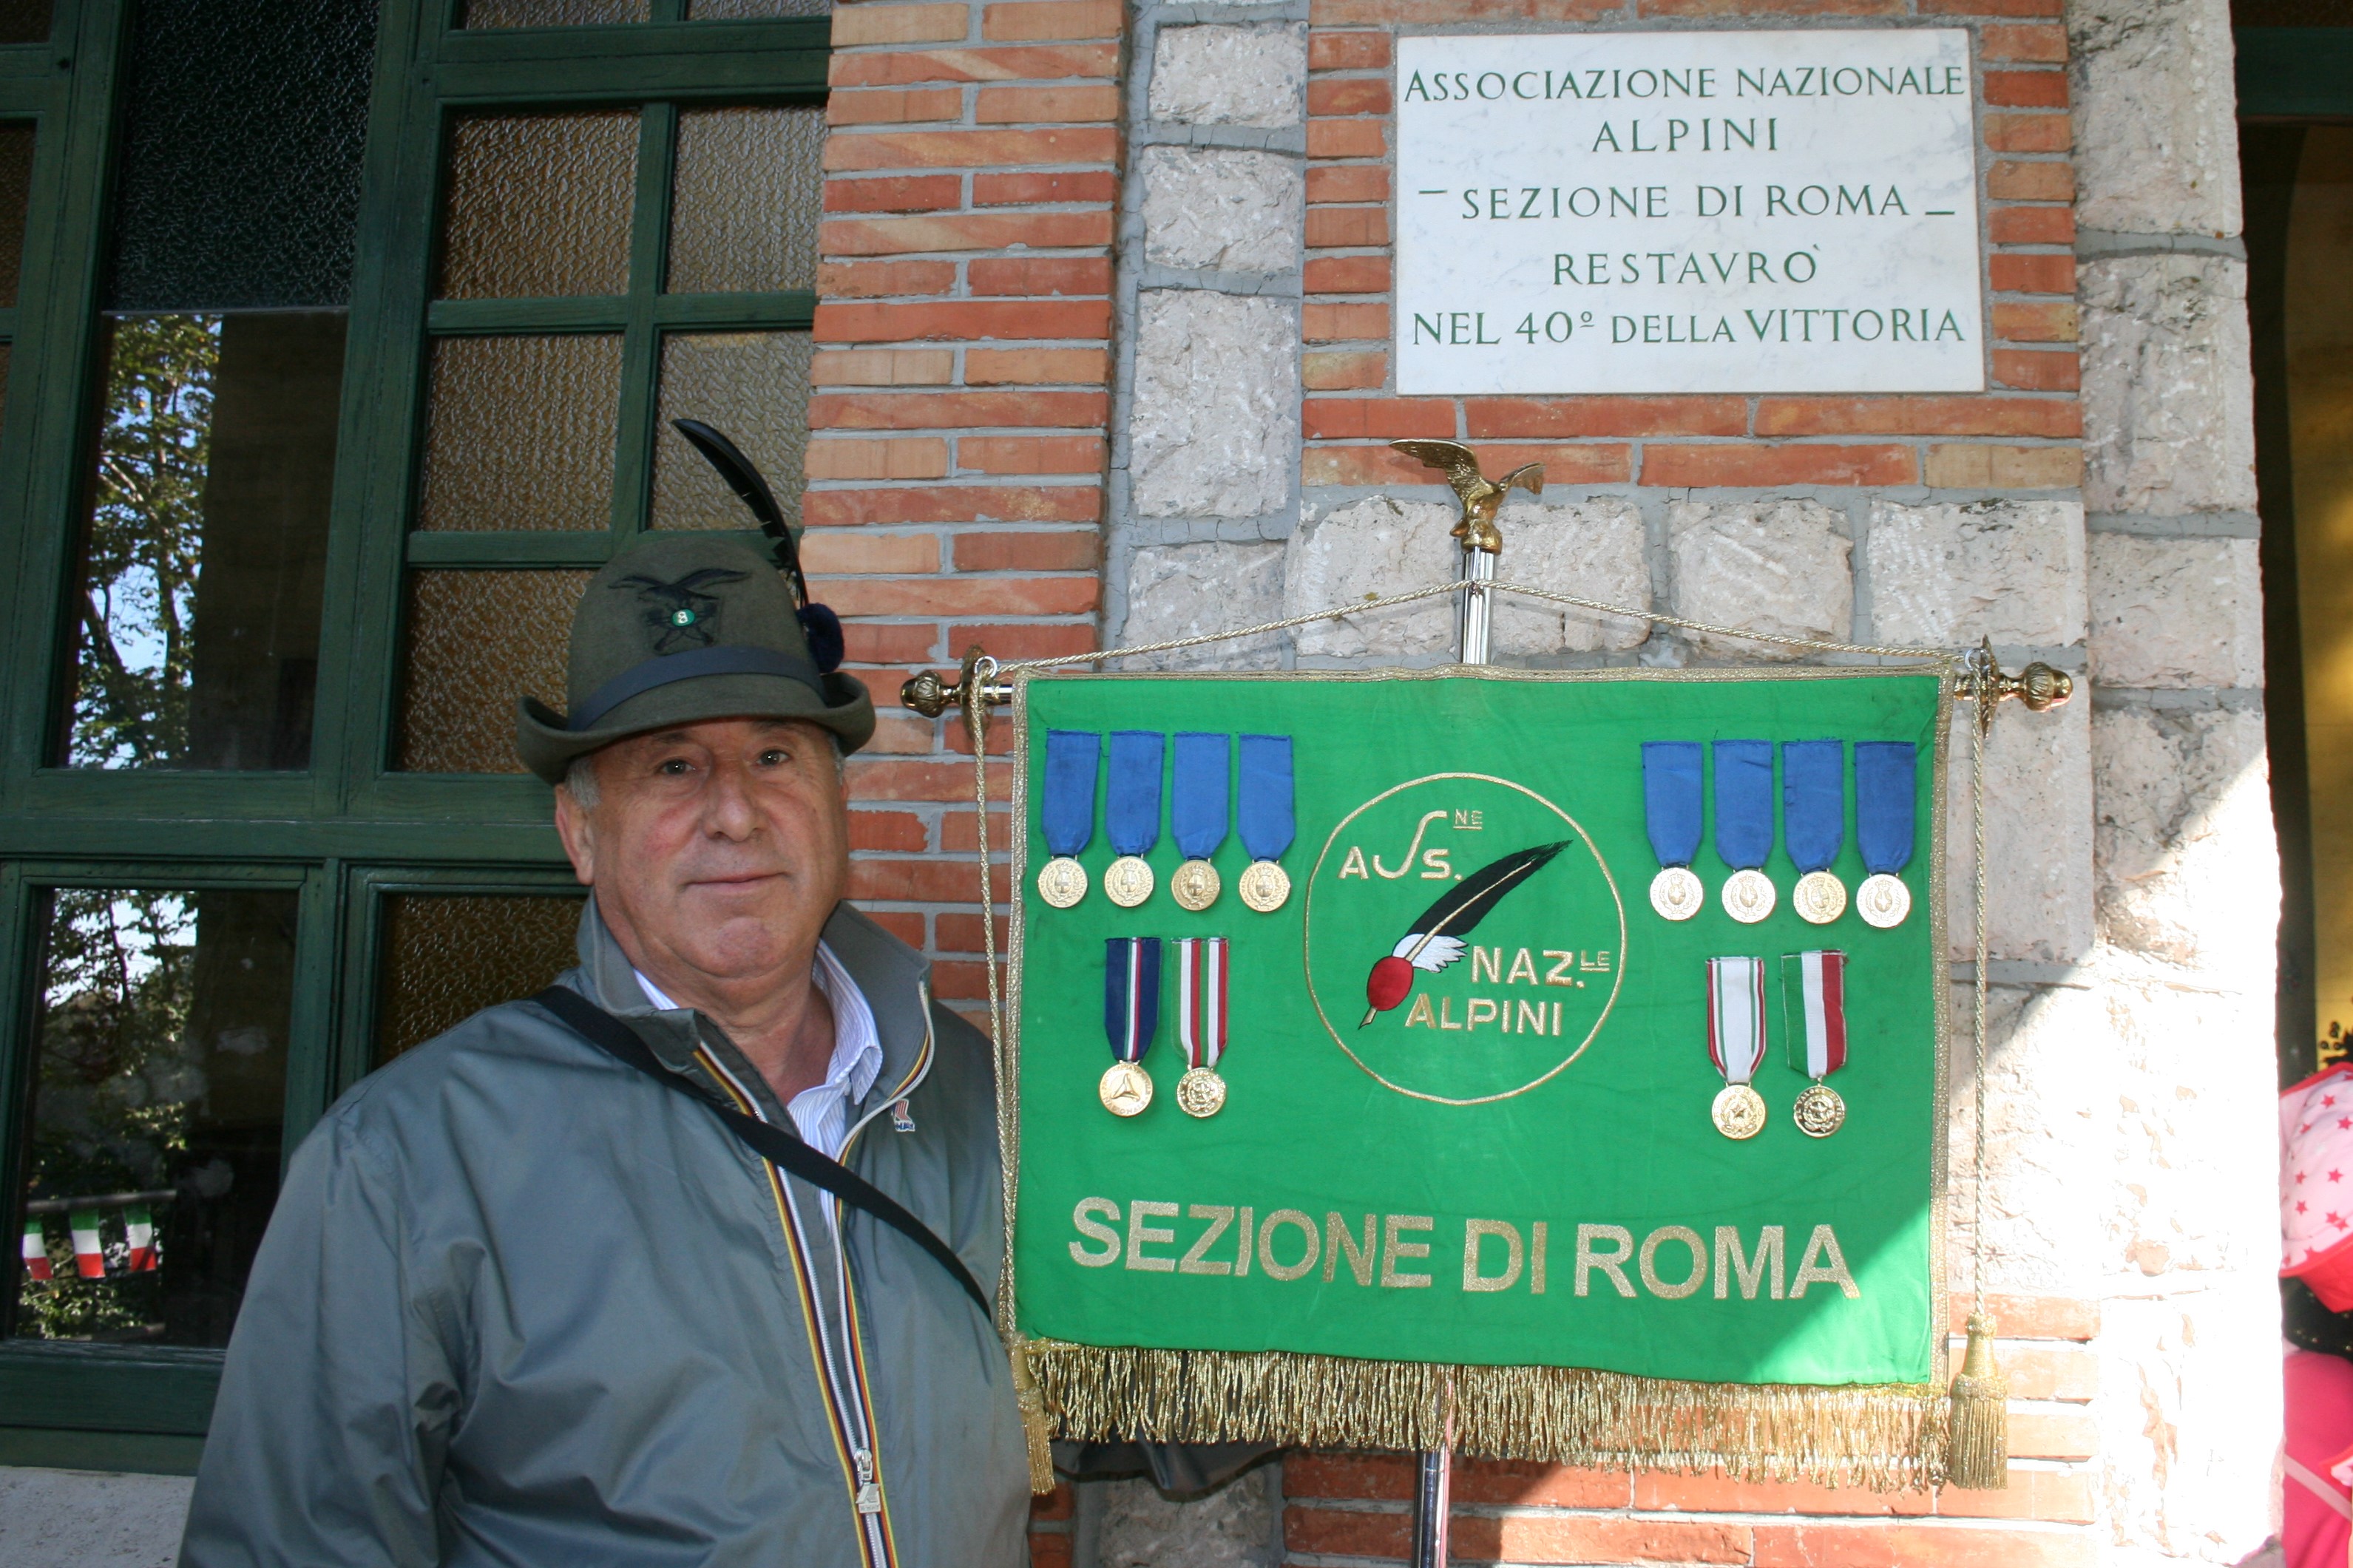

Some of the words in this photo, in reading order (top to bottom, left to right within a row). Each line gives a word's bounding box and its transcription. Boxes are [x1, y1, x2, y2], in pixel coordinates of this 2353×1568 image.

[1405, 69, 1714, 101] ASSOCIAZIONE
[1738, 67, 1963, 96] NAZIONALE
[1593, 118, 1776, 152] ALPINI
[1463, 186, 1668, 219] SEZIONE
[1698, 186, 1742, 216] DI
[1767, 185, 1909, 216] ROMA
[1414, 313, 1500, 345] NEL
[1612, 315, 1736, 343] DELLA
[1745, 308, 1964, 342] VITTORIA
[1404, 992, 1562, 1036] ALPINI
[1069, 1197, 1433, 1288] SEZIONE
[1463, 1219, 1547, 1294] DI
[1574, 1223, 1861, 1299] ROMA
